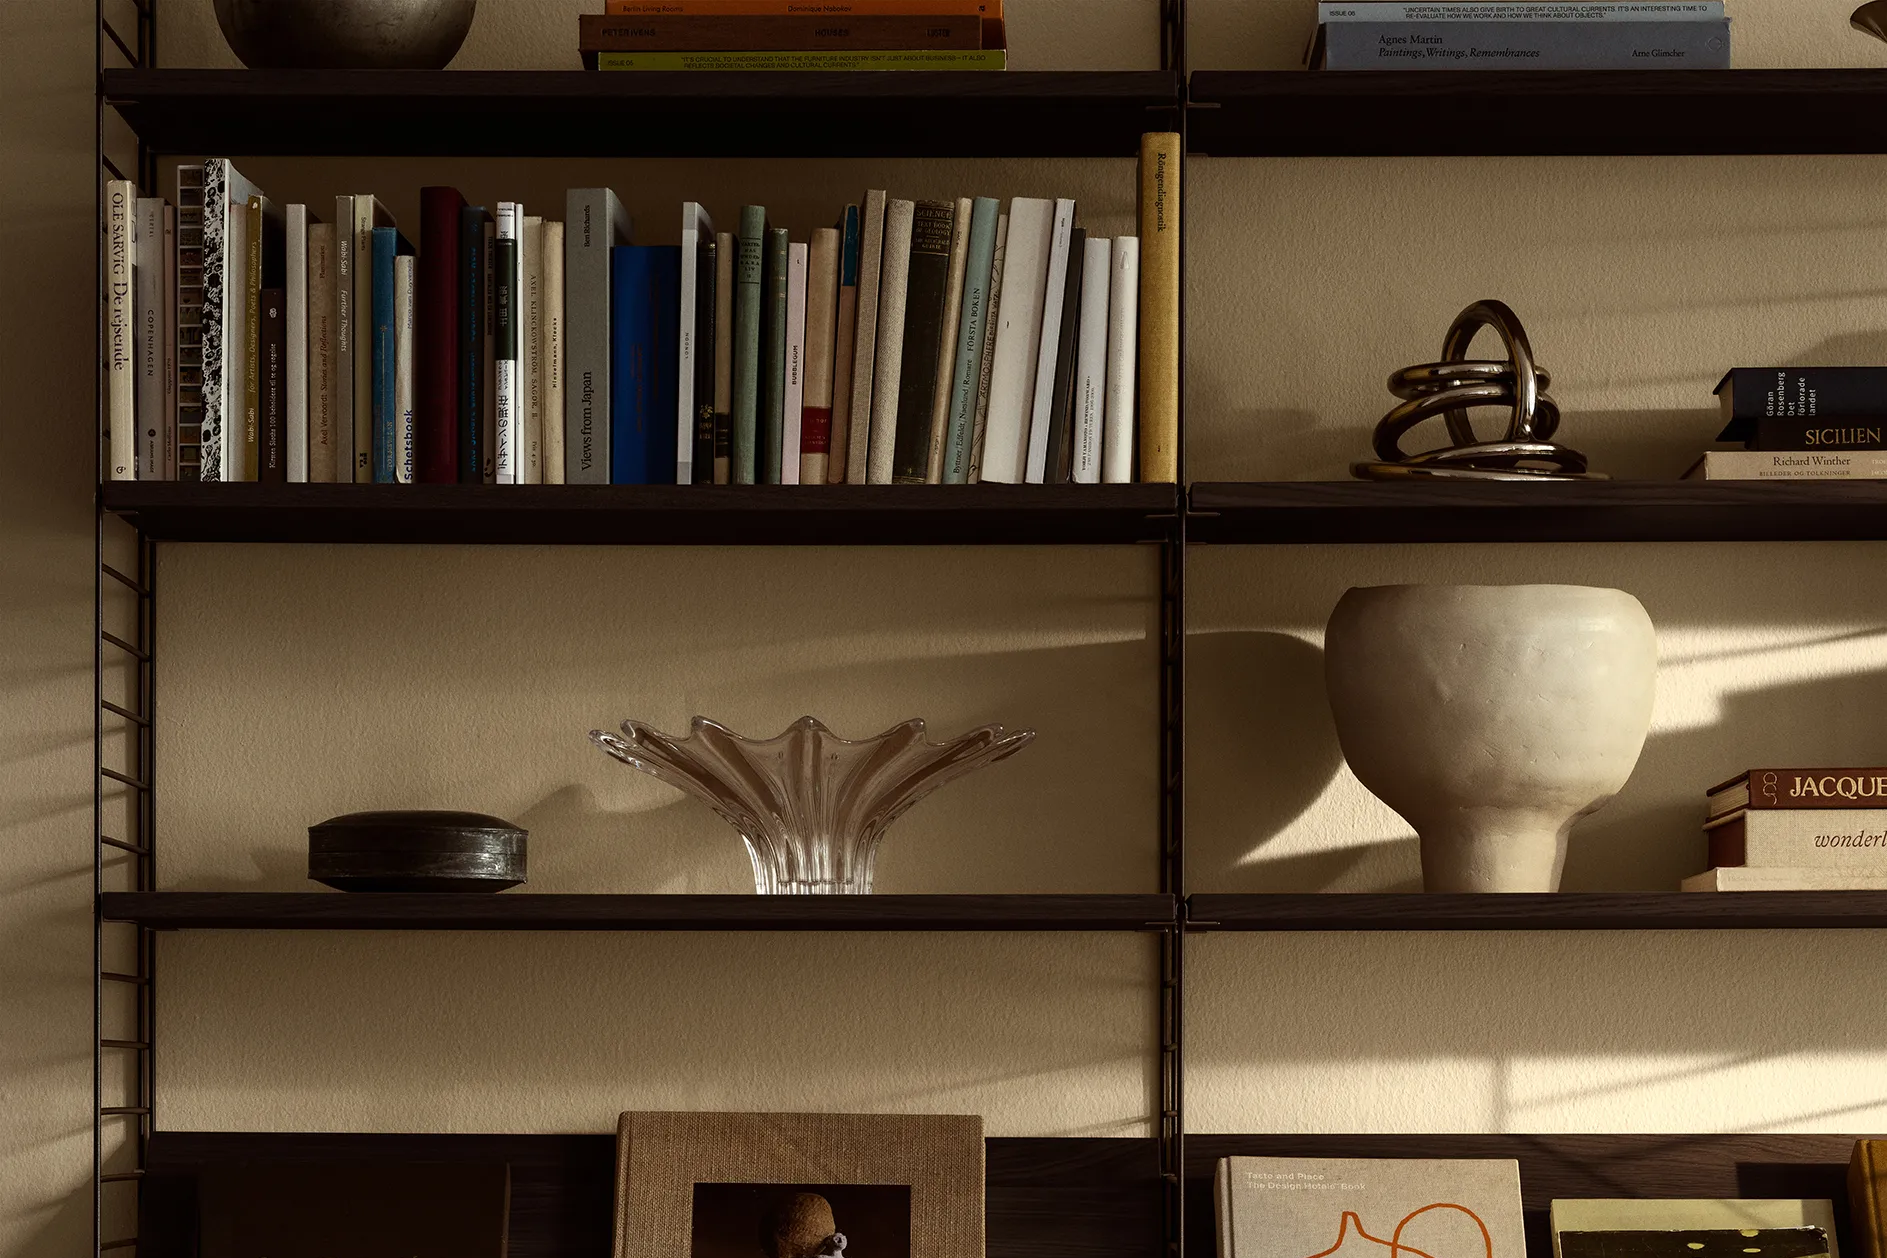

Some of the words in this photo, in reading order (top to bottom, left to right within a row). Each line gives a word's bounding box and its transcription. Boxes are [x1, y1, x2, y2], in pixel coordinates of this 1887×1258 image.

[788, 5, 821, 13] Dominique
[1378, 34, 1407, 46] Agnes
[1409, 34, 1443, 44] Martin
[1378, 47, 1426, 59] Paintings,
[1426, 47, 1468, 59] Writings,
[1470, 47, 1540, 58] Remembrances
[1632, 49, 1650, 57] Arne
[1651, 49, 1685, 57] Glimcher
[112, 193, 124, 221] OLE
[581, 205, 591, 235] Richards
[113, 224, 125, 275] SARVIG
[581, 236, 591, 248] Ben
[249, 241, 258, 286] Philosophers
[340, 240, 348, 275] Wabi-Sabi
[114, 283, 128, 306] De
[340, 290, 348, 316] Further
[969, 287, 981, 317] BOKEN
[111, 308, 129, 371] rejsende
[248, 316, 257, 353] Designers,
[320, 316, 329, 352] Reflections
[340, 318, 348, 352] Thoughts
[965, 319, 977, 351] FÖRSTA
[320, 354, 328, 368] and
[248, 382, 257, 393] for
[320, 369, 328, 391] Stories
[581, 371, 594, 406] Japan
[1766, 391, 1774, 417] Göran
[1777, 372, 1786, 417] Rosenberg
[1797, 376, 1806, 416] förlorade
[1808, 389, 1816, 417] landet
[580, 407, 591, 436] from
[1787, 402, 1795, 417] Det
[404, 410, 413, 480] Schetsboek
[1805, 428, 1881, 445] SICILIEN
[581, 437, 592, 471] Views
[1773, 456, 1810, 467] Richard
[1812, 456, 1851, 467] Winther
[1247, 1172, 1272, 1180] Taste
[1276, 1172, 1295, 1180] and
[1297, 1172, 1325, 1181] Place
[1247, 1181, 1266, 1190] The
[1267, 1181, 1302, 1192] Design
[1342, 1182, 1367, 1191] Book
